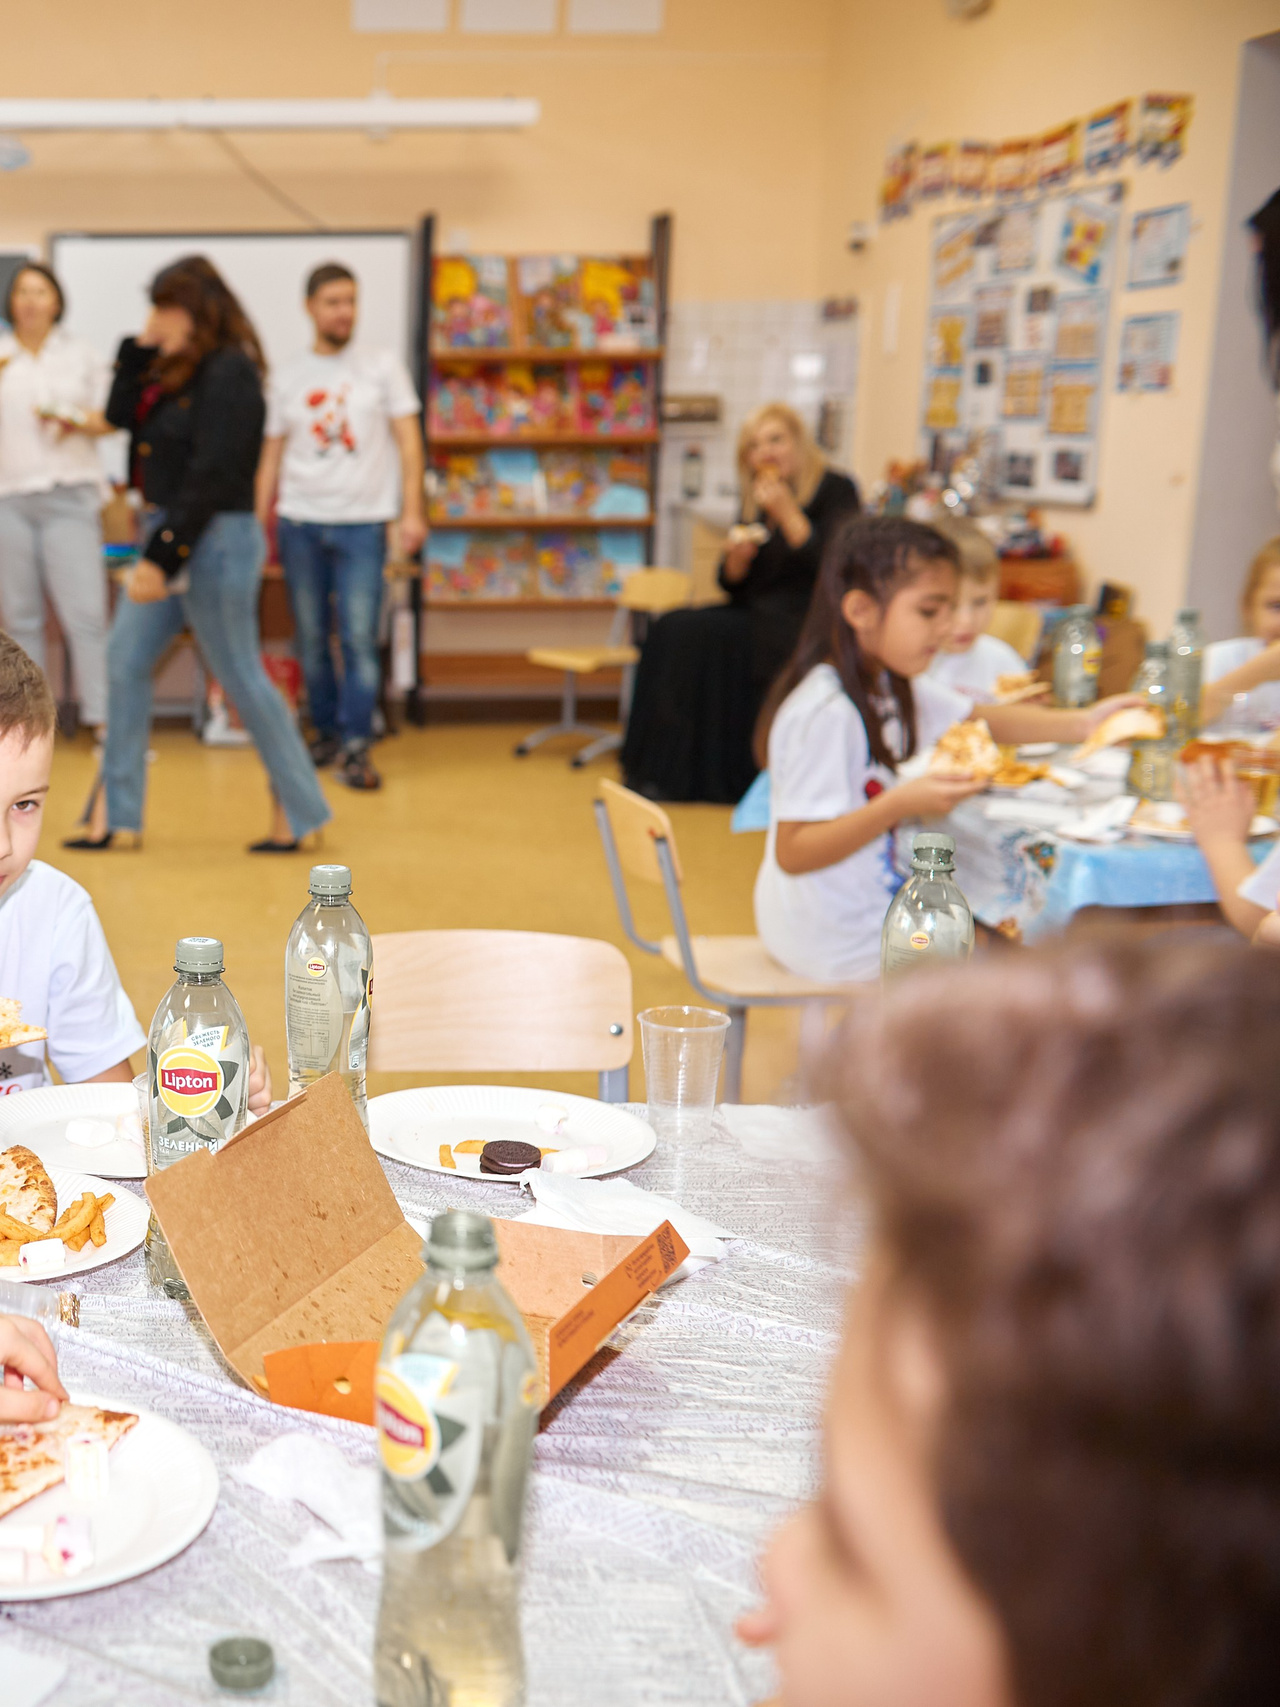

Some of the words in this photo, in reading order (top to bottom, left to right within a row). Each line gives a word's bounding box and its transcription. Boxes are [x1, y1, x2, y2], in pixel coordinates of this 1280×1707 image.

[191, 1030, 220, 1041] СВЕЖЕСТЬ
[193, 1035, 221, 1046] ЗЕЛЕНОГО
[164, 1072, 213, 1090] Lipton
